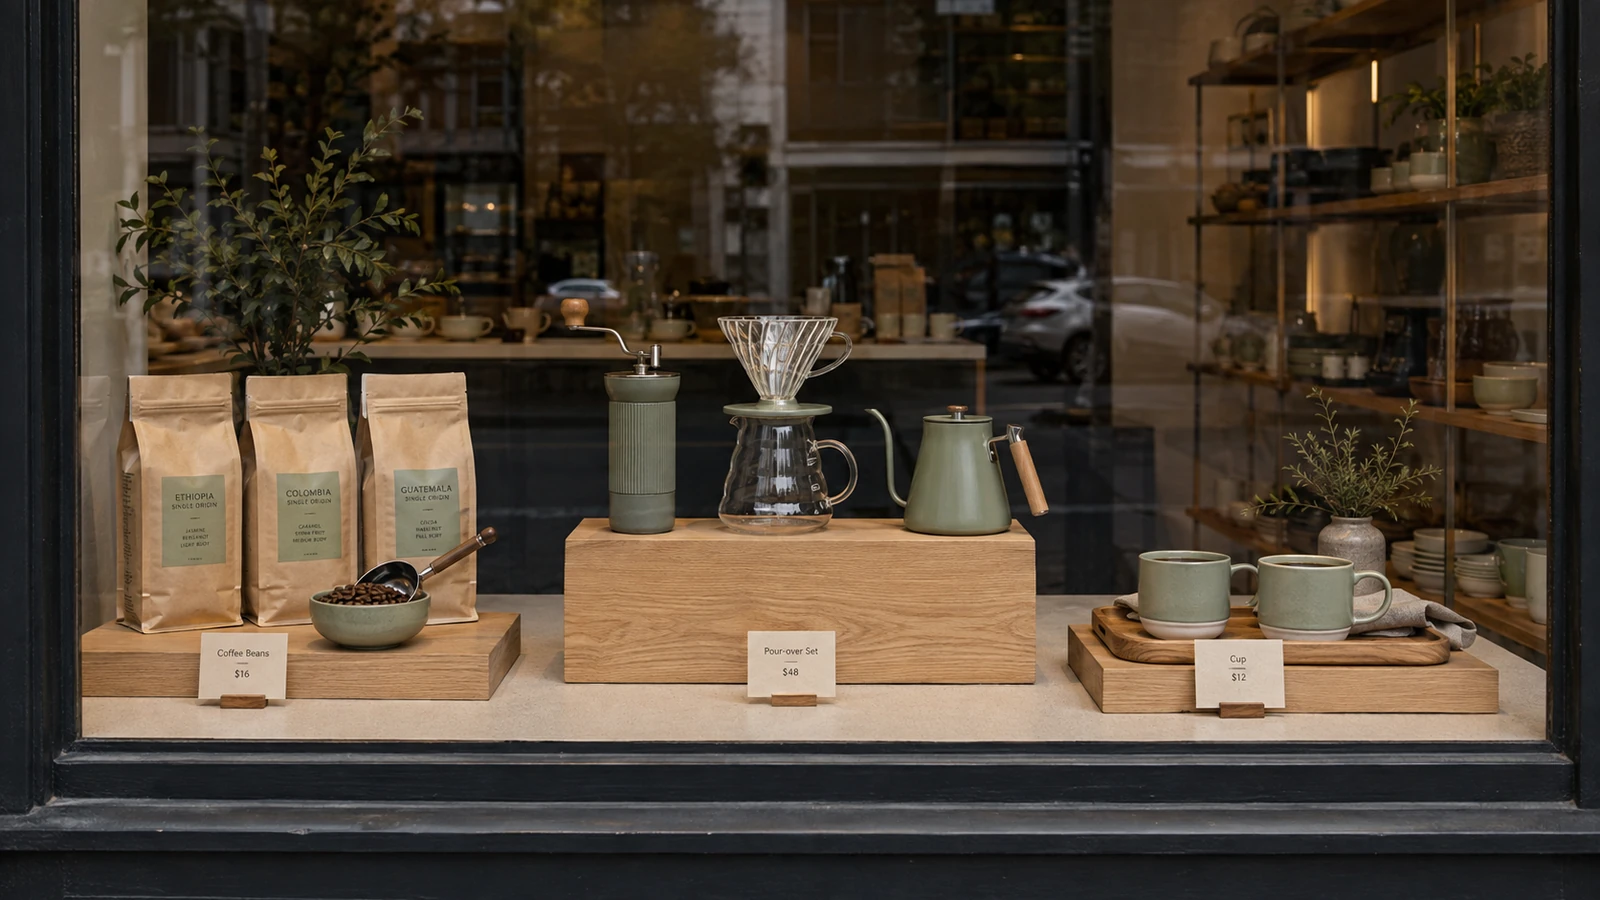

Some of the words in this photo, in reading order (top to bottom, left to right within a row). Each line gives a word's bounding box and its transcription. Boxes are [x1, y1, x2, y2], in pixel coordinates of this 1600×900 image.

[286, 488, 331, 497] COLOMBIA
[401, 485, 452, 494] GUATEMALA
[175, 492, 214, 501] ETHIOPIA
[217, 648, 243, 657] Coffee
[245, 649, 270, 657] Beans
[764, 647, 803, 655] Pour-over
[805, 647, 819, 655] Set
[1229, 654, 1247, 665] Cup
[234, 669, 250, 678] $16
[782, 668, 799, 676] $48
[1231, 673, 1246, 682] $12
